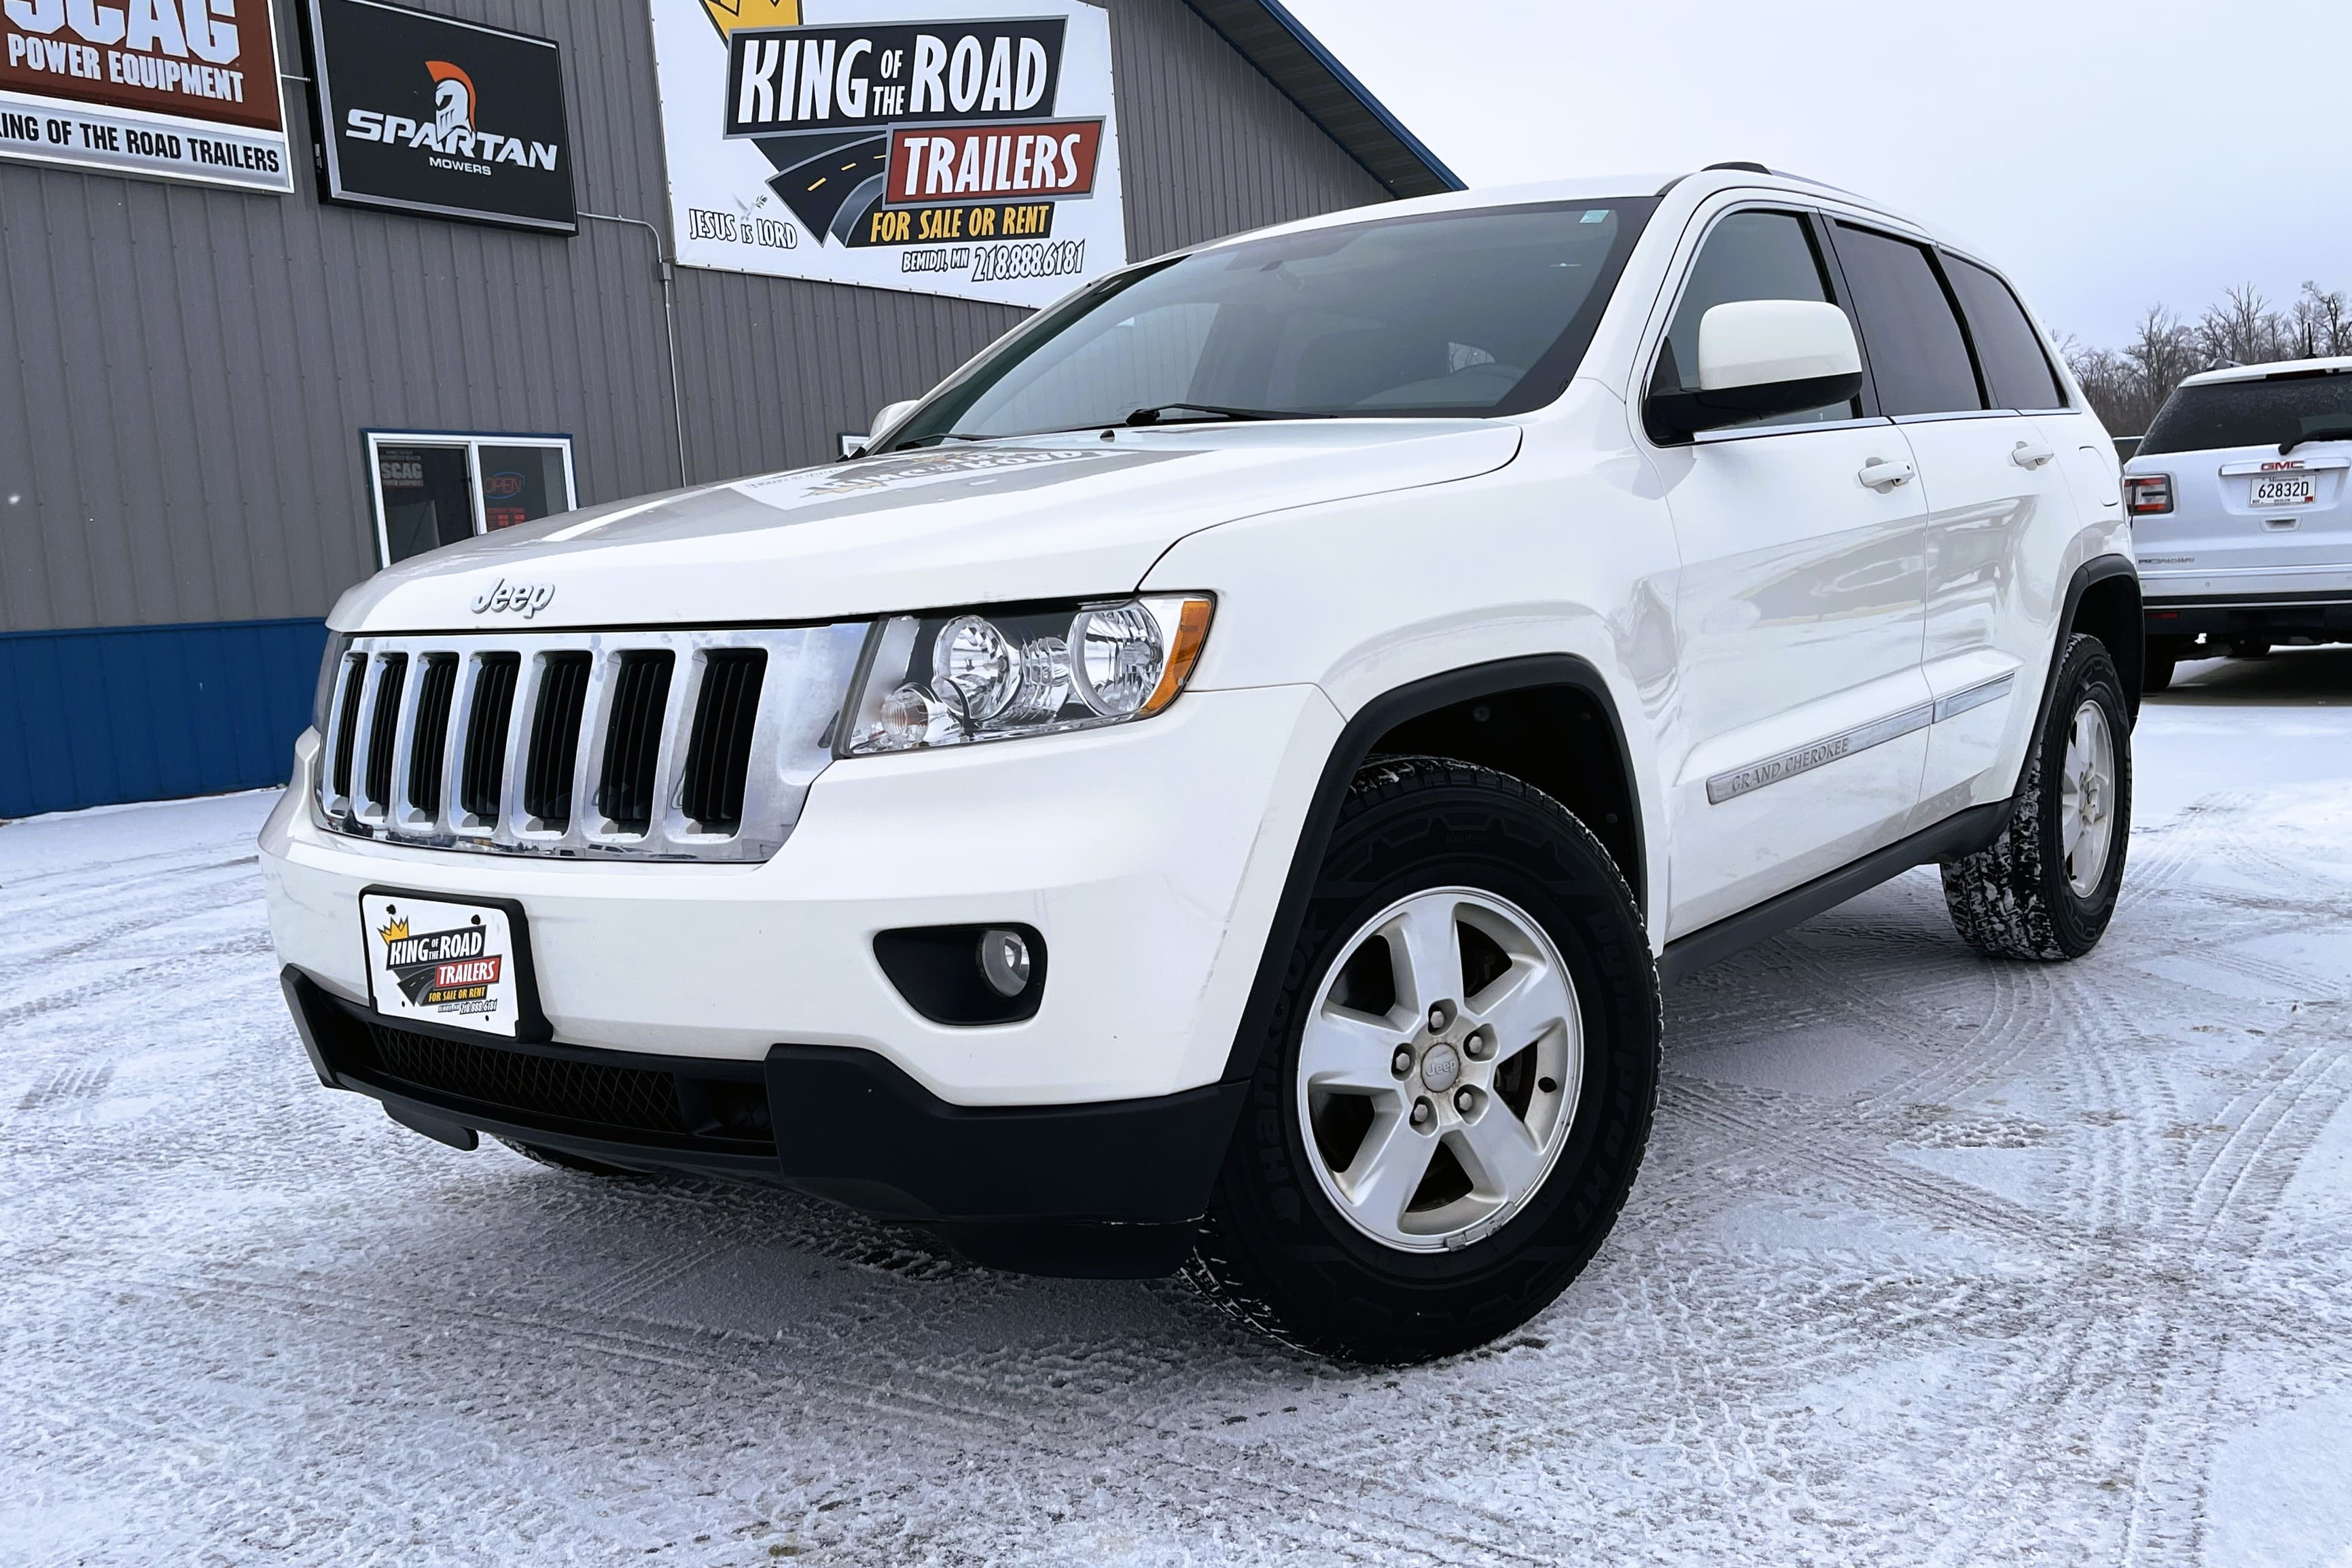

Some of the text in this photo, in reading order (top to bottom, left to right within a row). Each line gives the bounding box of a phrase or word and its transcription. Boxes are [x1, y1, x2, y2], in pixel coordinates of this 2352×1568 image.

[7, 33, 244, 103] POWER EQUIPMENT
[738, 34, 1048, 124] KING OF THE ROAD
[0, 112, 279, 173] ING OF THE ROAD TRAILERS
[346, 109, 558, 171] SPARTAN
[429, 156, 492, 176] MOWERS
[904, 133, 1081, 196] TRAILERS
[689, 208, 798, 249] JESUS IS LORD
[870, 205, 1050, 243] FOR SALE OR RENT
[902, 249, 948, 273] BEMIDJI,
[950, 247, 969, 269] MN
[380, 462, 423, 479] SCAG
[2260, 460, 2304, 471] GMC
[483, 478, 522, 494] OPEN
[470, 577, 555, 619] Jeep
[1730, 737, 1849, 794] GRAND CHEROKEE
[390, 931, 482, 965] KING OF THE ROAD
[440, 961, 495, 985] TRAILERS
[429, 986, 486, 1002] FOR SALE OR RENT
[1425, 1061, 1457, 1077] Jeep
